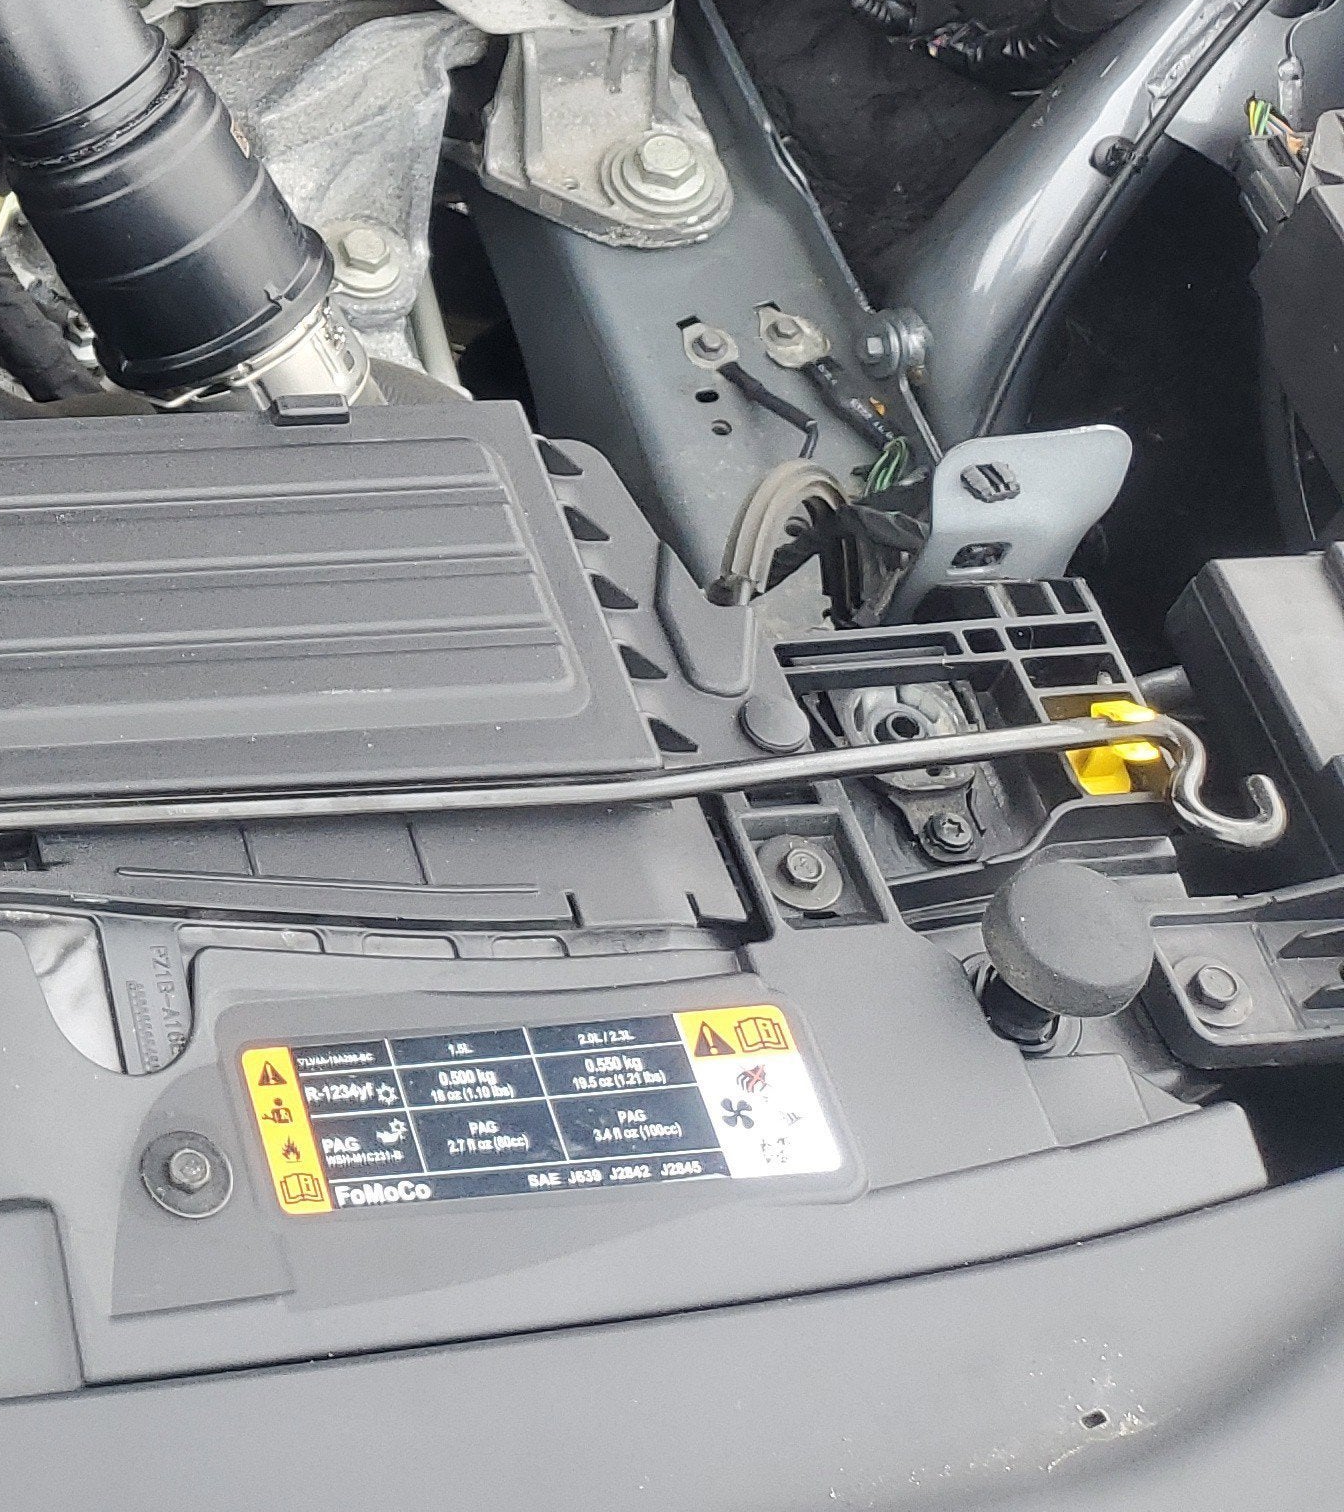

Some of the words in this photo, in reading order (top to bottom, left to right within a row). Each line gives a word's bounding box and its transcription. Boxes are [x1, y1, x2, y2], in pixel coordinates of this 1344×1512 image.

[622, 1054, 643, 1071] kg
[438, 1069, 477, 1087] 0.500
[475, 1067, 498, 1086] kg
[304, 1081, 375, 1104] R-1234yf
[616, 1108, 647, 1124] PAG
[468, 1120, 500, 1136] PAG
[321, 1135, 361, 1154] PAG
[527, 1172, 561, 1188] SAE
[334, 1179, 433, 1209] FoMoCo
